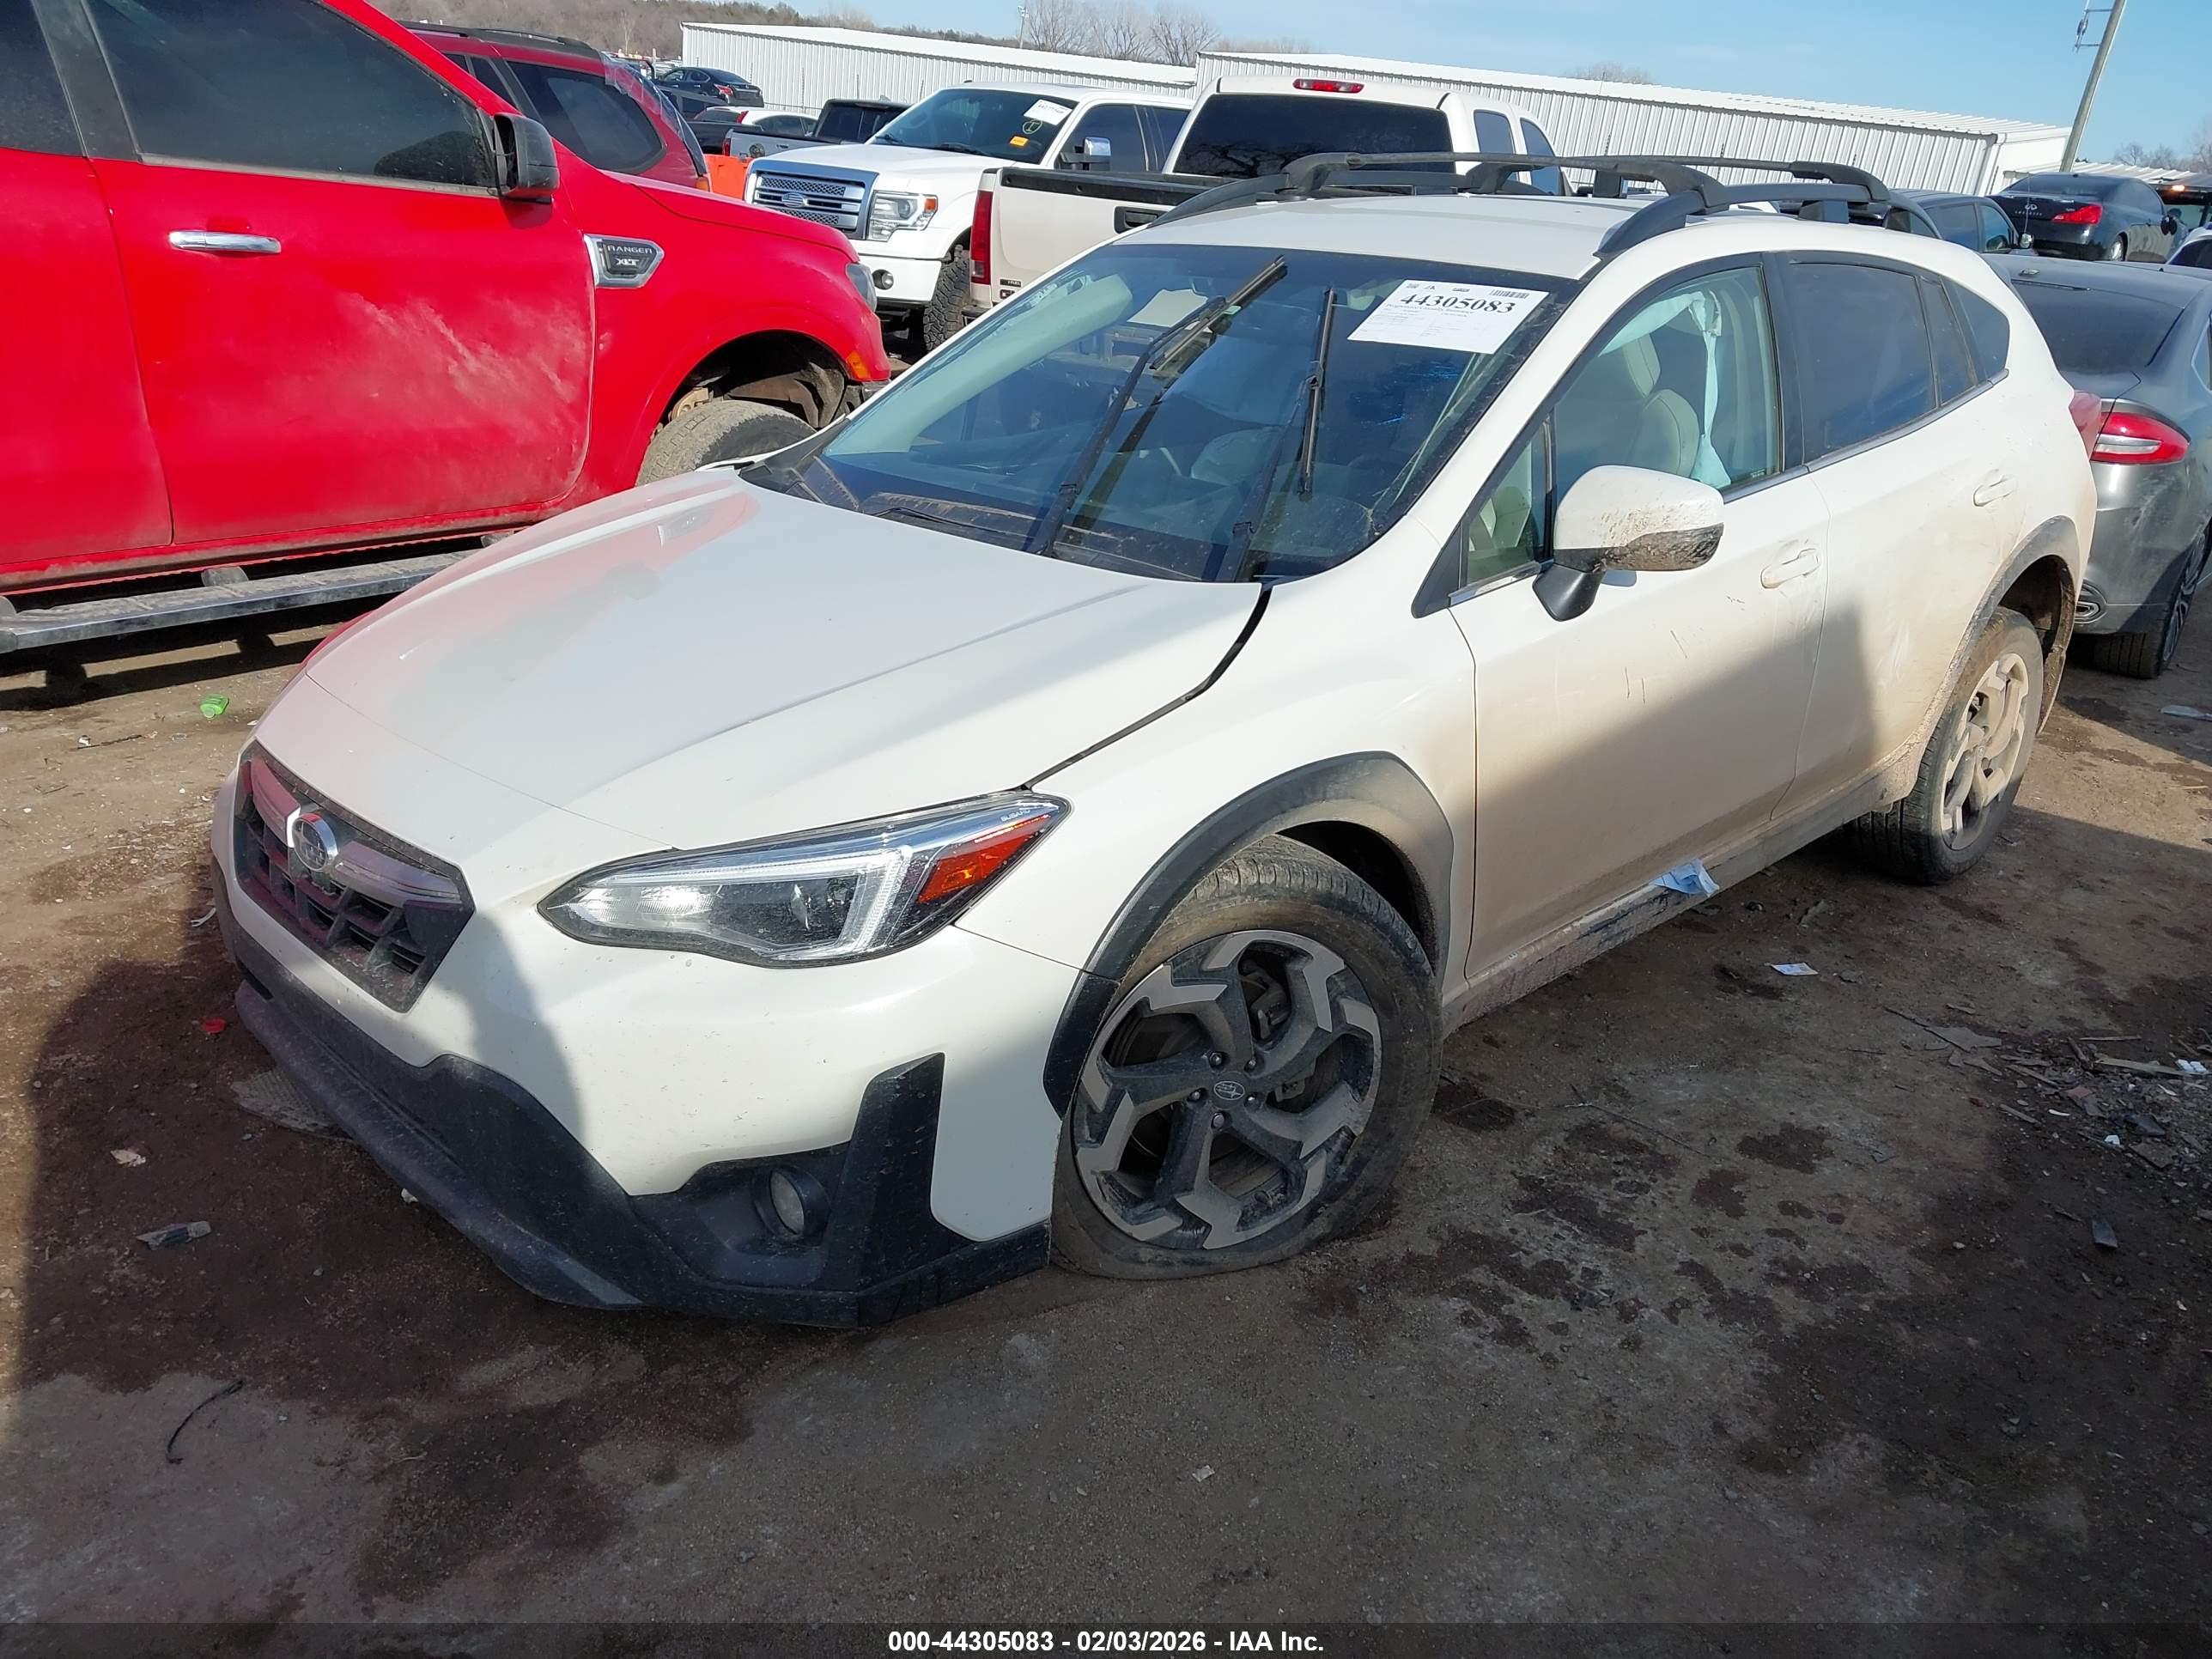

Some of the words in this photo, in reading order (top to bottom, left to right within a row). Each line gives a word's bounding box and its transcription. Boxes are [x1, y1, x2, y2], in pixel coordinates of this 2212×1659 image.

[607, 245, 653, 254] RANGER
[616, 258, 640, 266] XLT
[1401, 294, 1516, 313] 44305083
